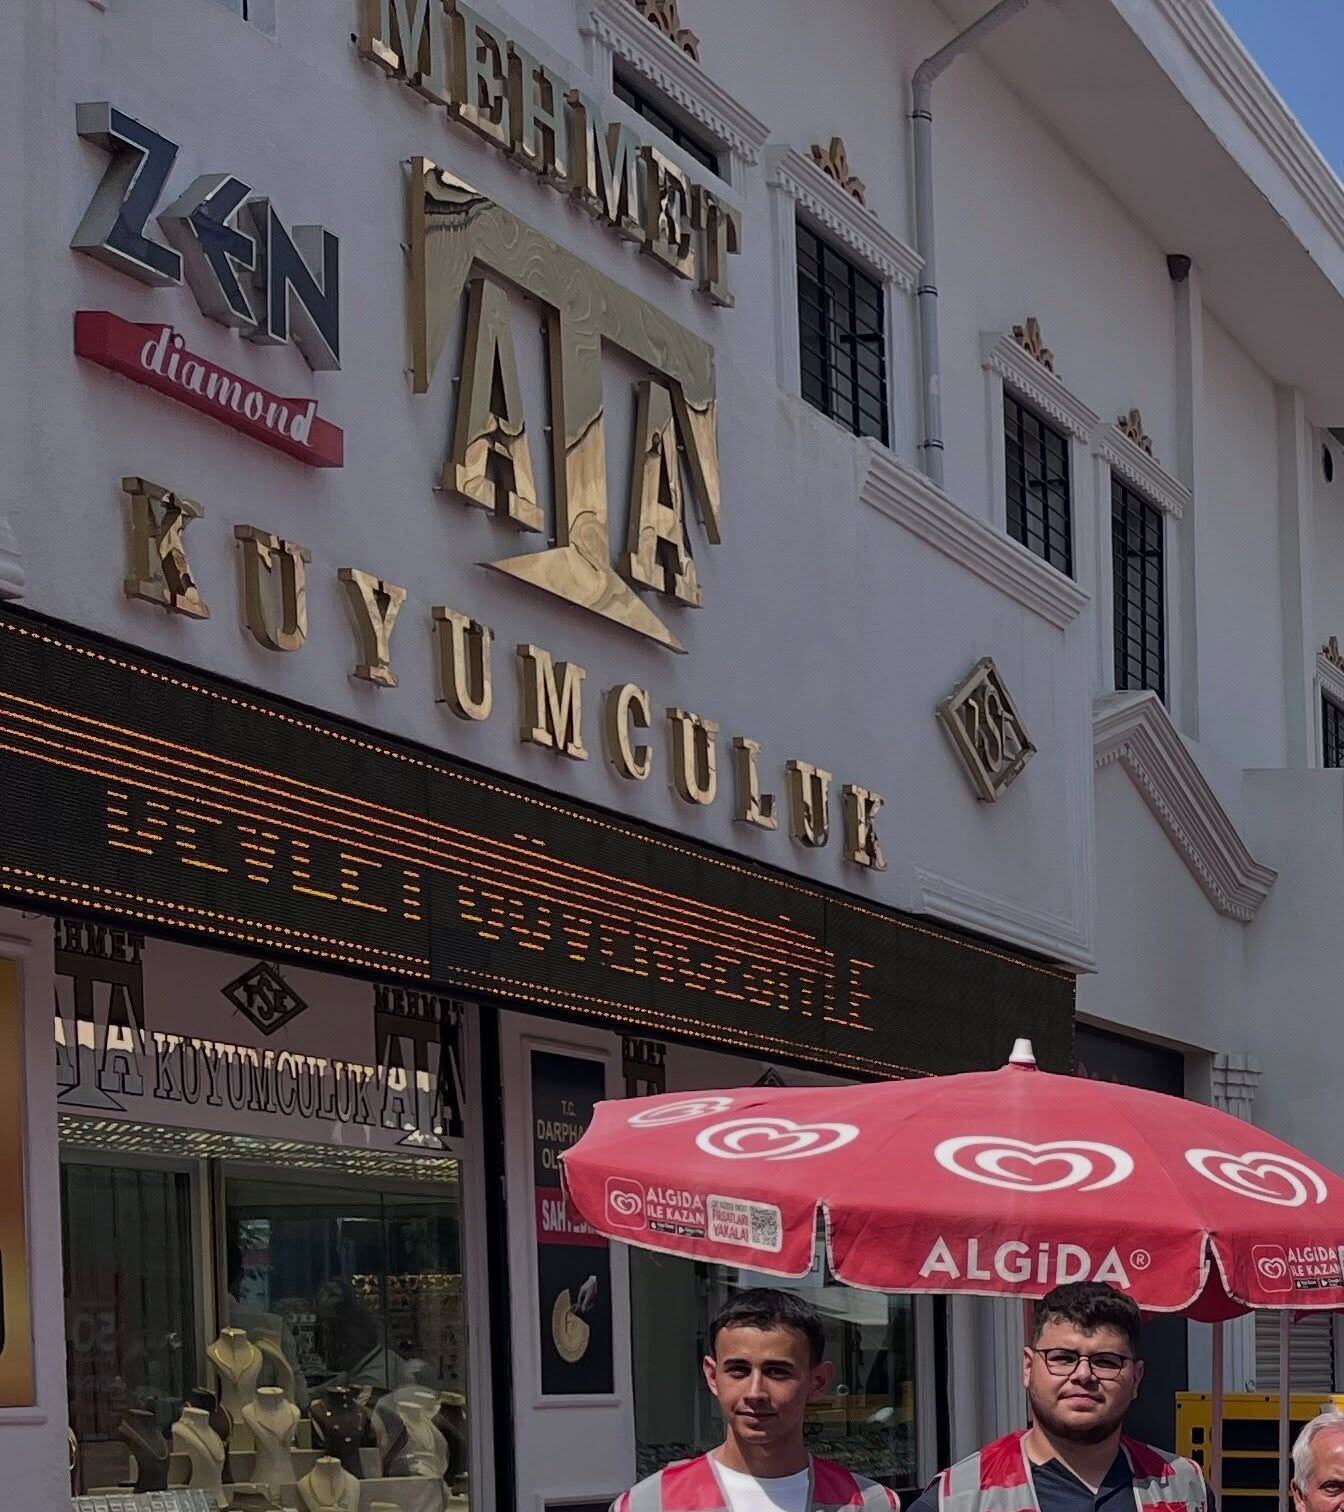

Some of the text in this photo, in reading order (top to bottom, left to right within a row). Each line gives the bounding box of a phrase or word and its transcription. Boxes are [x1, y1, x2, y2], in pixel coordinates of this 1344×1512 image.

[71, 101, 341, 371] ZEN
[359, 0, 742, 308] MEHMET
[140, 325, 316, 449] diamond
[122, 477, 889, 873] KUYUMCULUK
[153, 1031, 379, 1128] KUYUMCULUK
[666, 1207, 705, 1226] KAZAN
